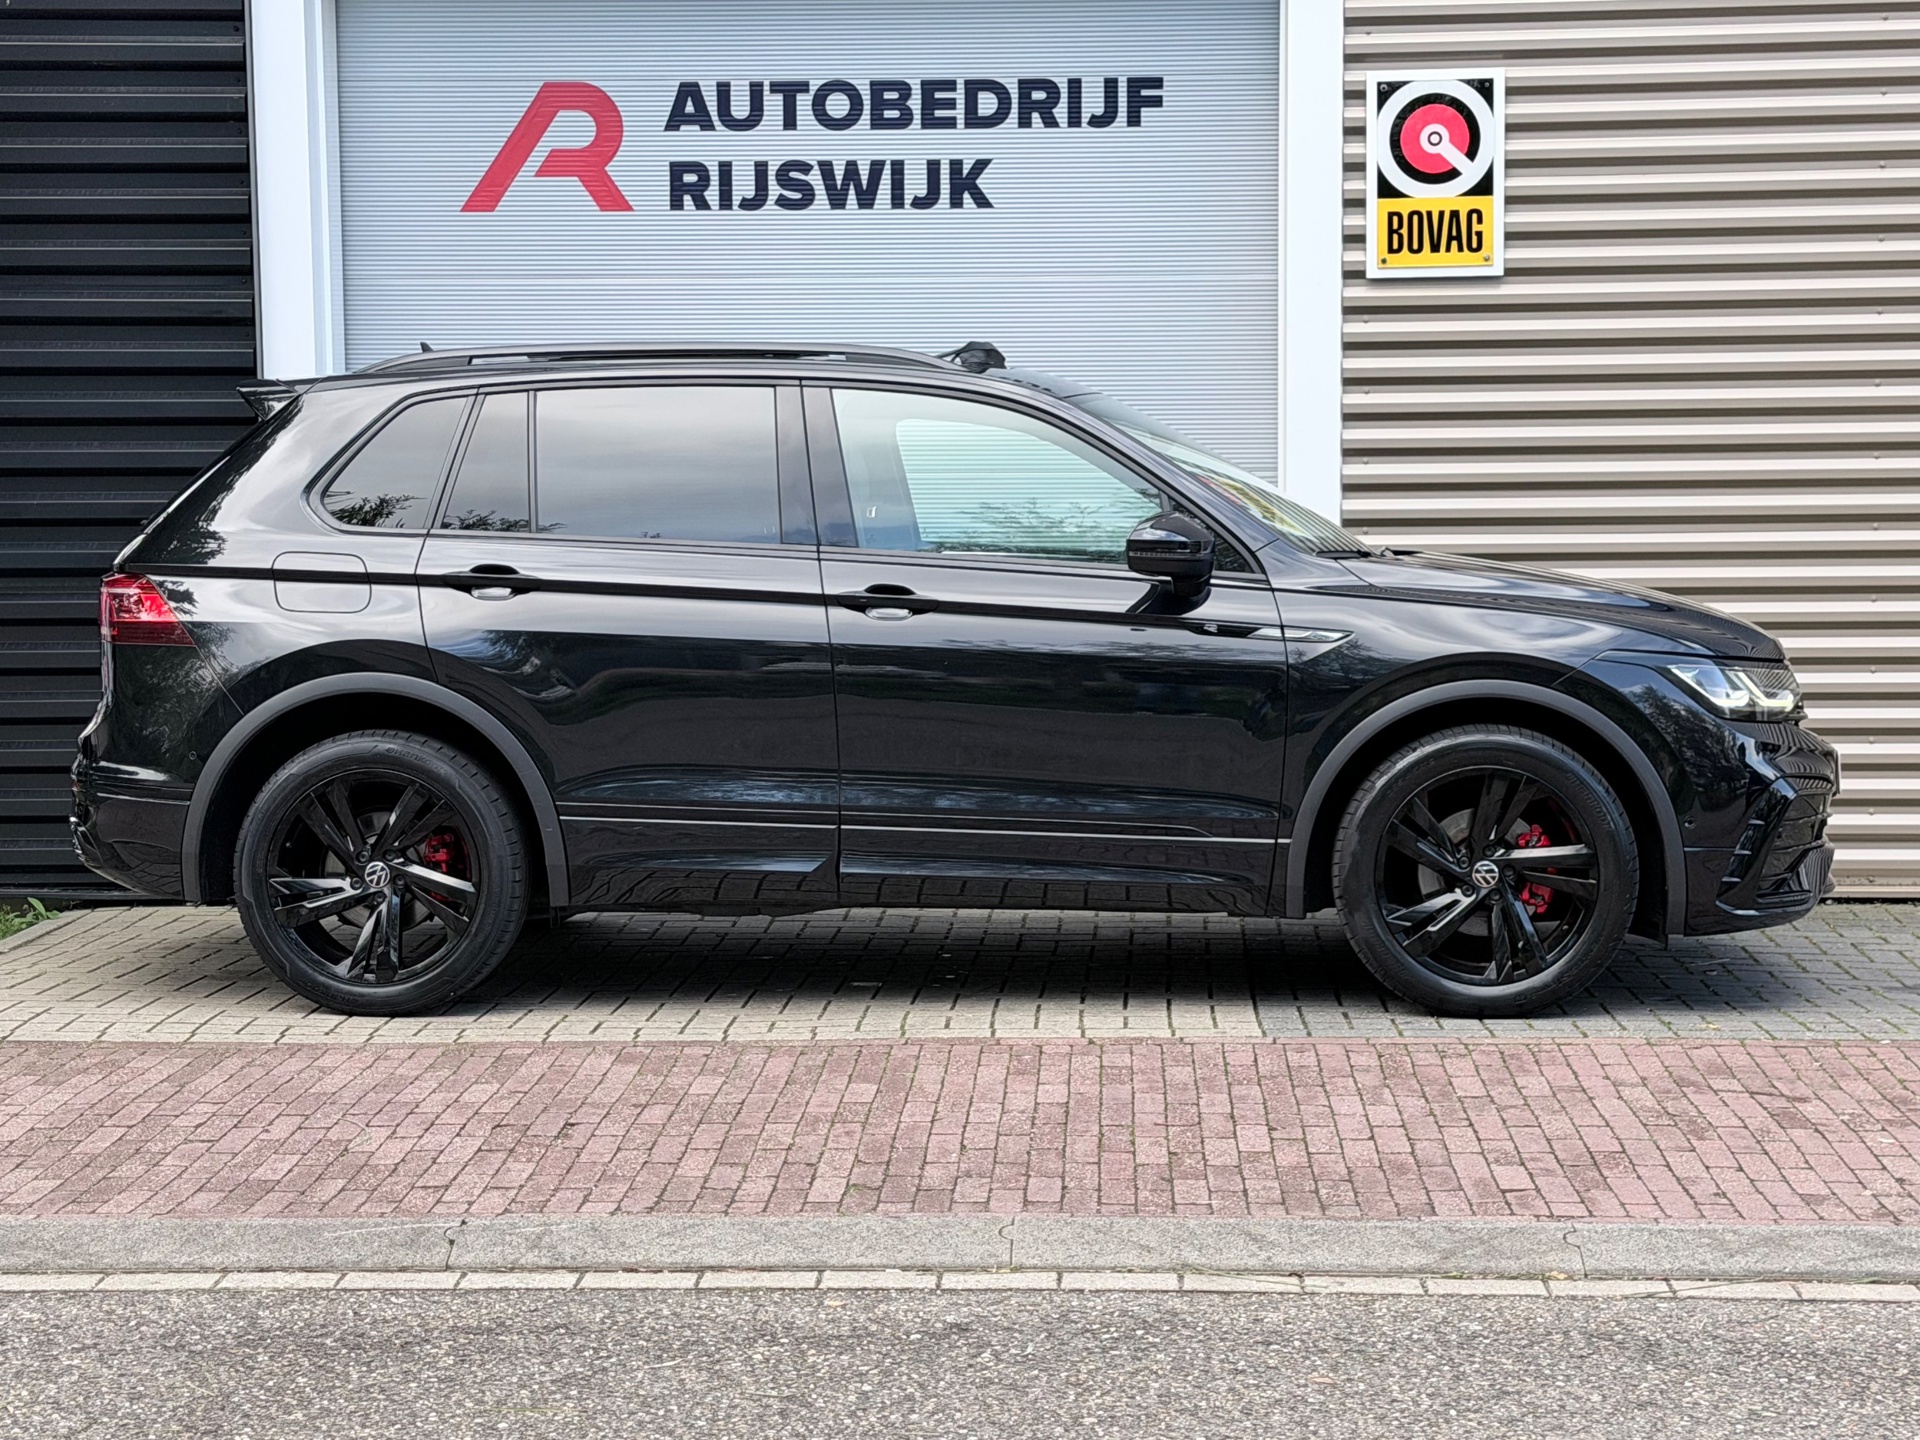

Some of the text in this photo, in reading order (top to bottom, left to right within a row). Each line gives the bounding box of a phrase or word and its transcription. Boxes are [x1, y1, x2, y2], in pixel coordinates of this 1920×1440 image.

[664, 76, 1165, 132] AUTOBEDRIJF
[668, 158, 994, 211] RIJSWIJK
[1386, 208, 1484, 255] BOVAG
